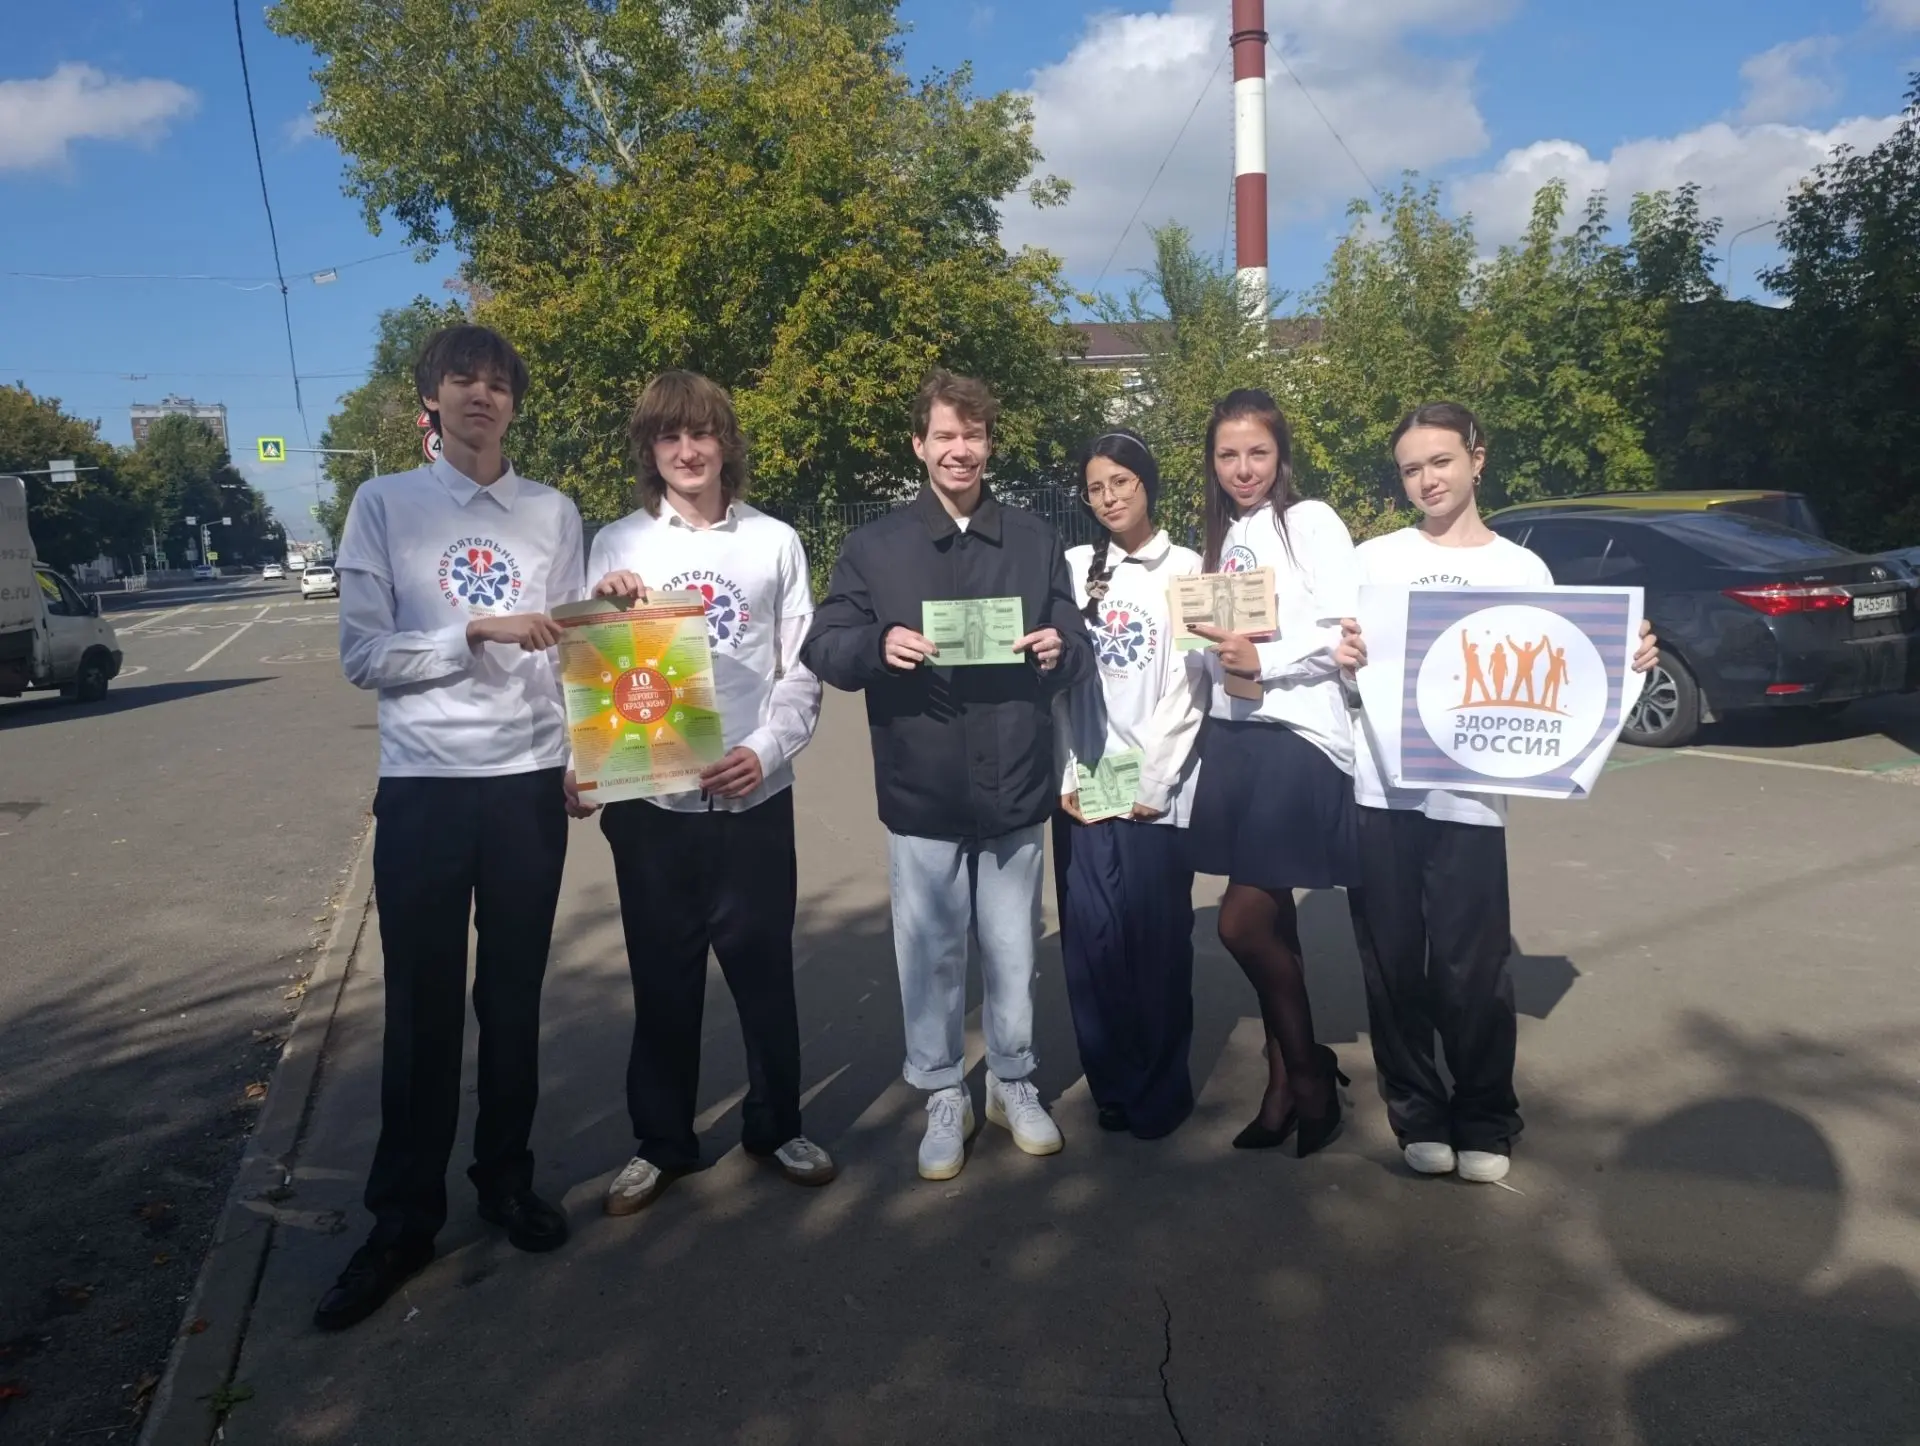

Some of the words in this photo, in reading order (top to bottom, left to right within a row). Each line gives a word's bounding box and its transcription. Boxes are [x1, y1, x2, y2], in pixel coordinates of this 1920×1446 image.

[432, 439, 442, 452] 4
[631, 672, 651, 687] 10
[1455, 715, 1562, 734] ЗДОРОВАЯ
[1453, 732, 1561, 757] РОССИЯ
